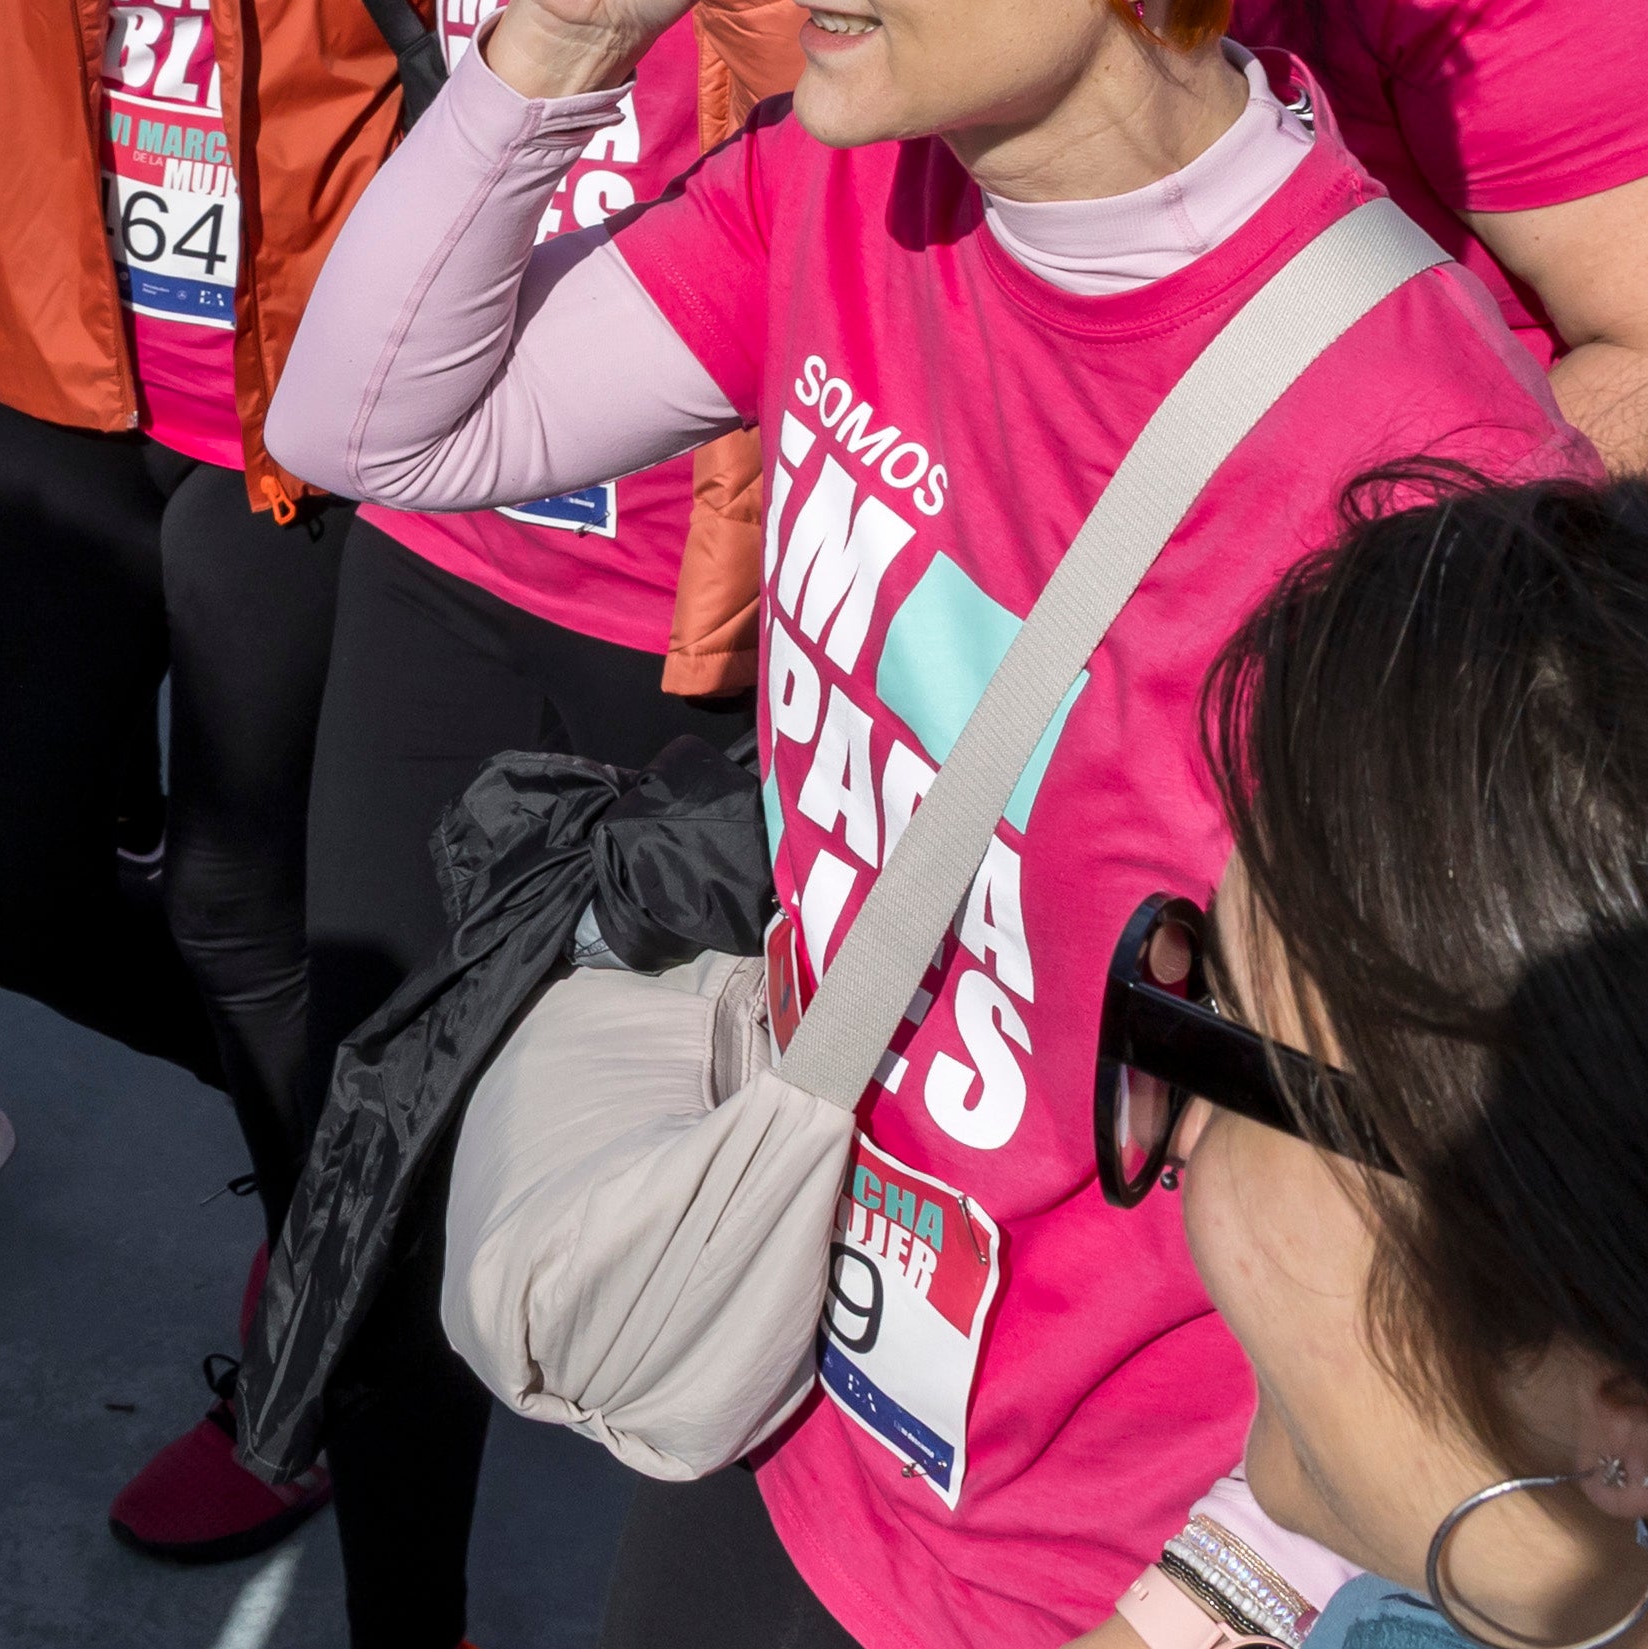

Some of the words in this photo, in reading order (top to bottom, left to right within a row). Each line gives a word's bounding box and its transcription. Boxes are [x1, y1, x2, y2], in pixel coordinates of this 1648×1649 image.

[136, 119, 231, 166] MARC
[793, 354, 949, 518] SOMOS
[853, 1165, 945, 1253] CHA
